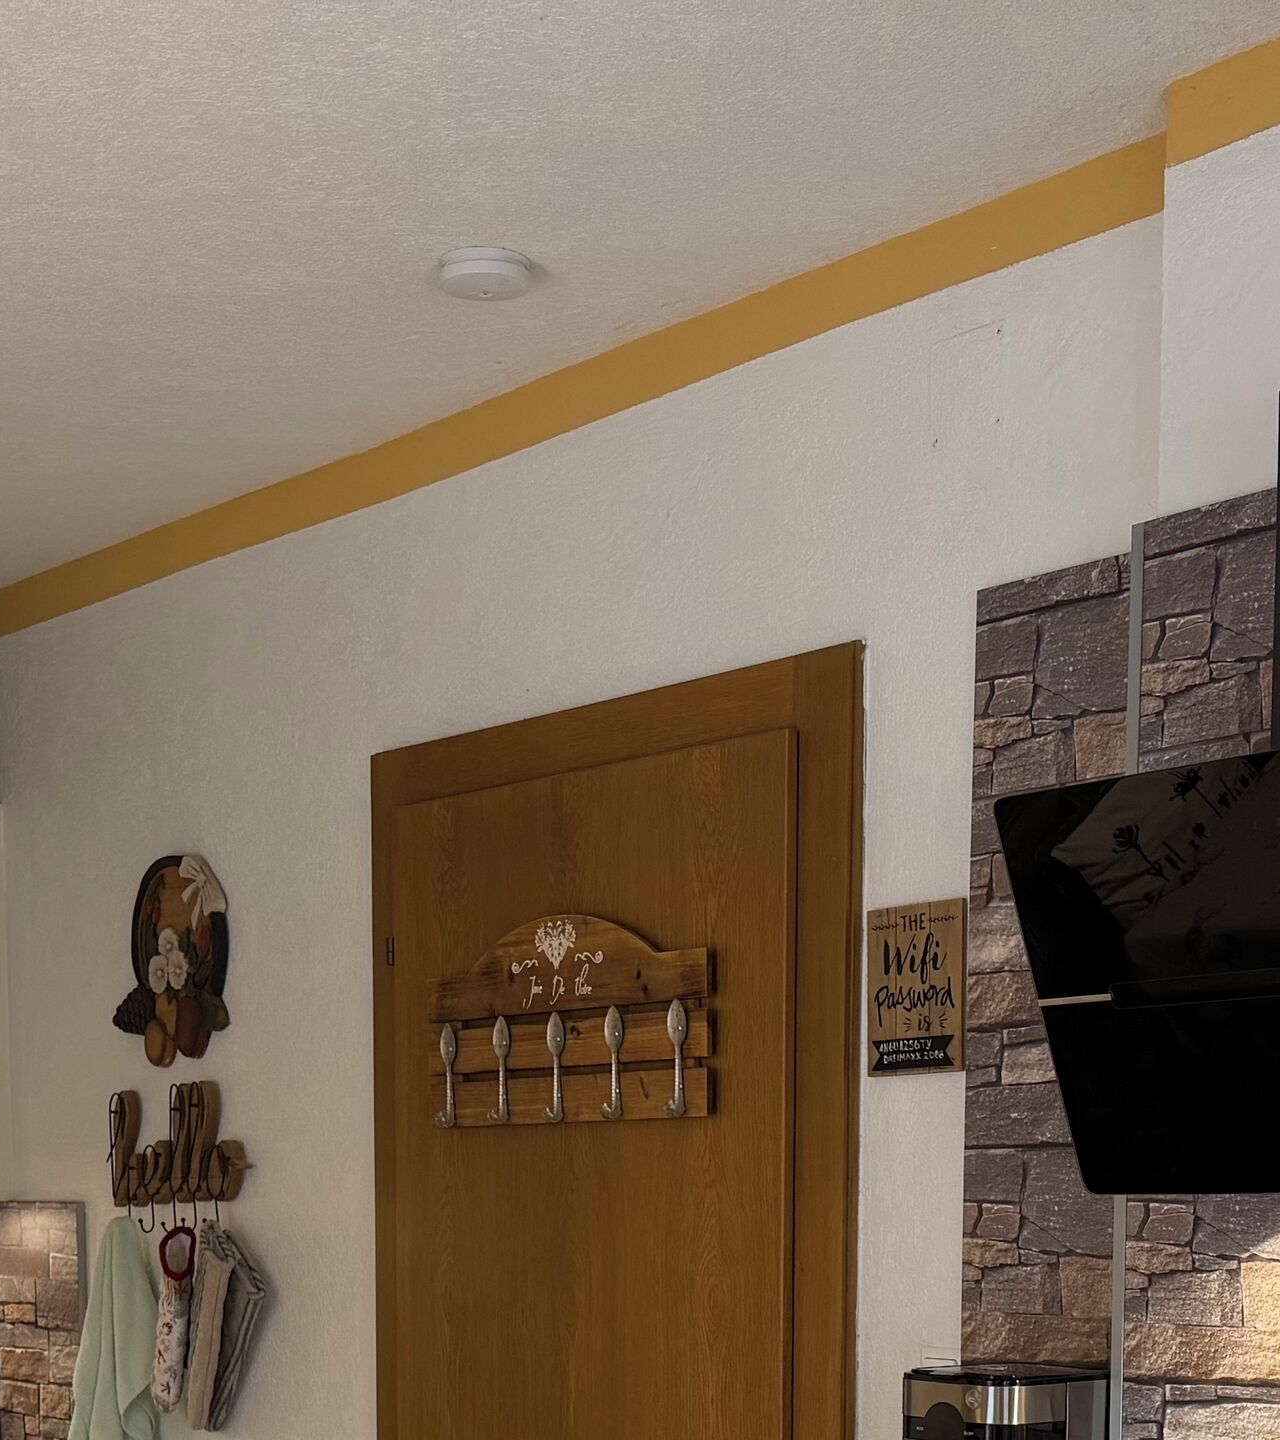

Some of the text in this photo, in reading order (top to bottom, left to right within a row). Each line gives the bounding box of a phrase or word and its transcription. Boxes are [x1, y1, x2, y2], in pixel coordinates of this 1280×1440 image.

[900, 912, 926, 932] THE
[883, 932, 947, 984] Wifi
[550, 975, 565, 1005] De
[918, 1013, 933, 1032] is
